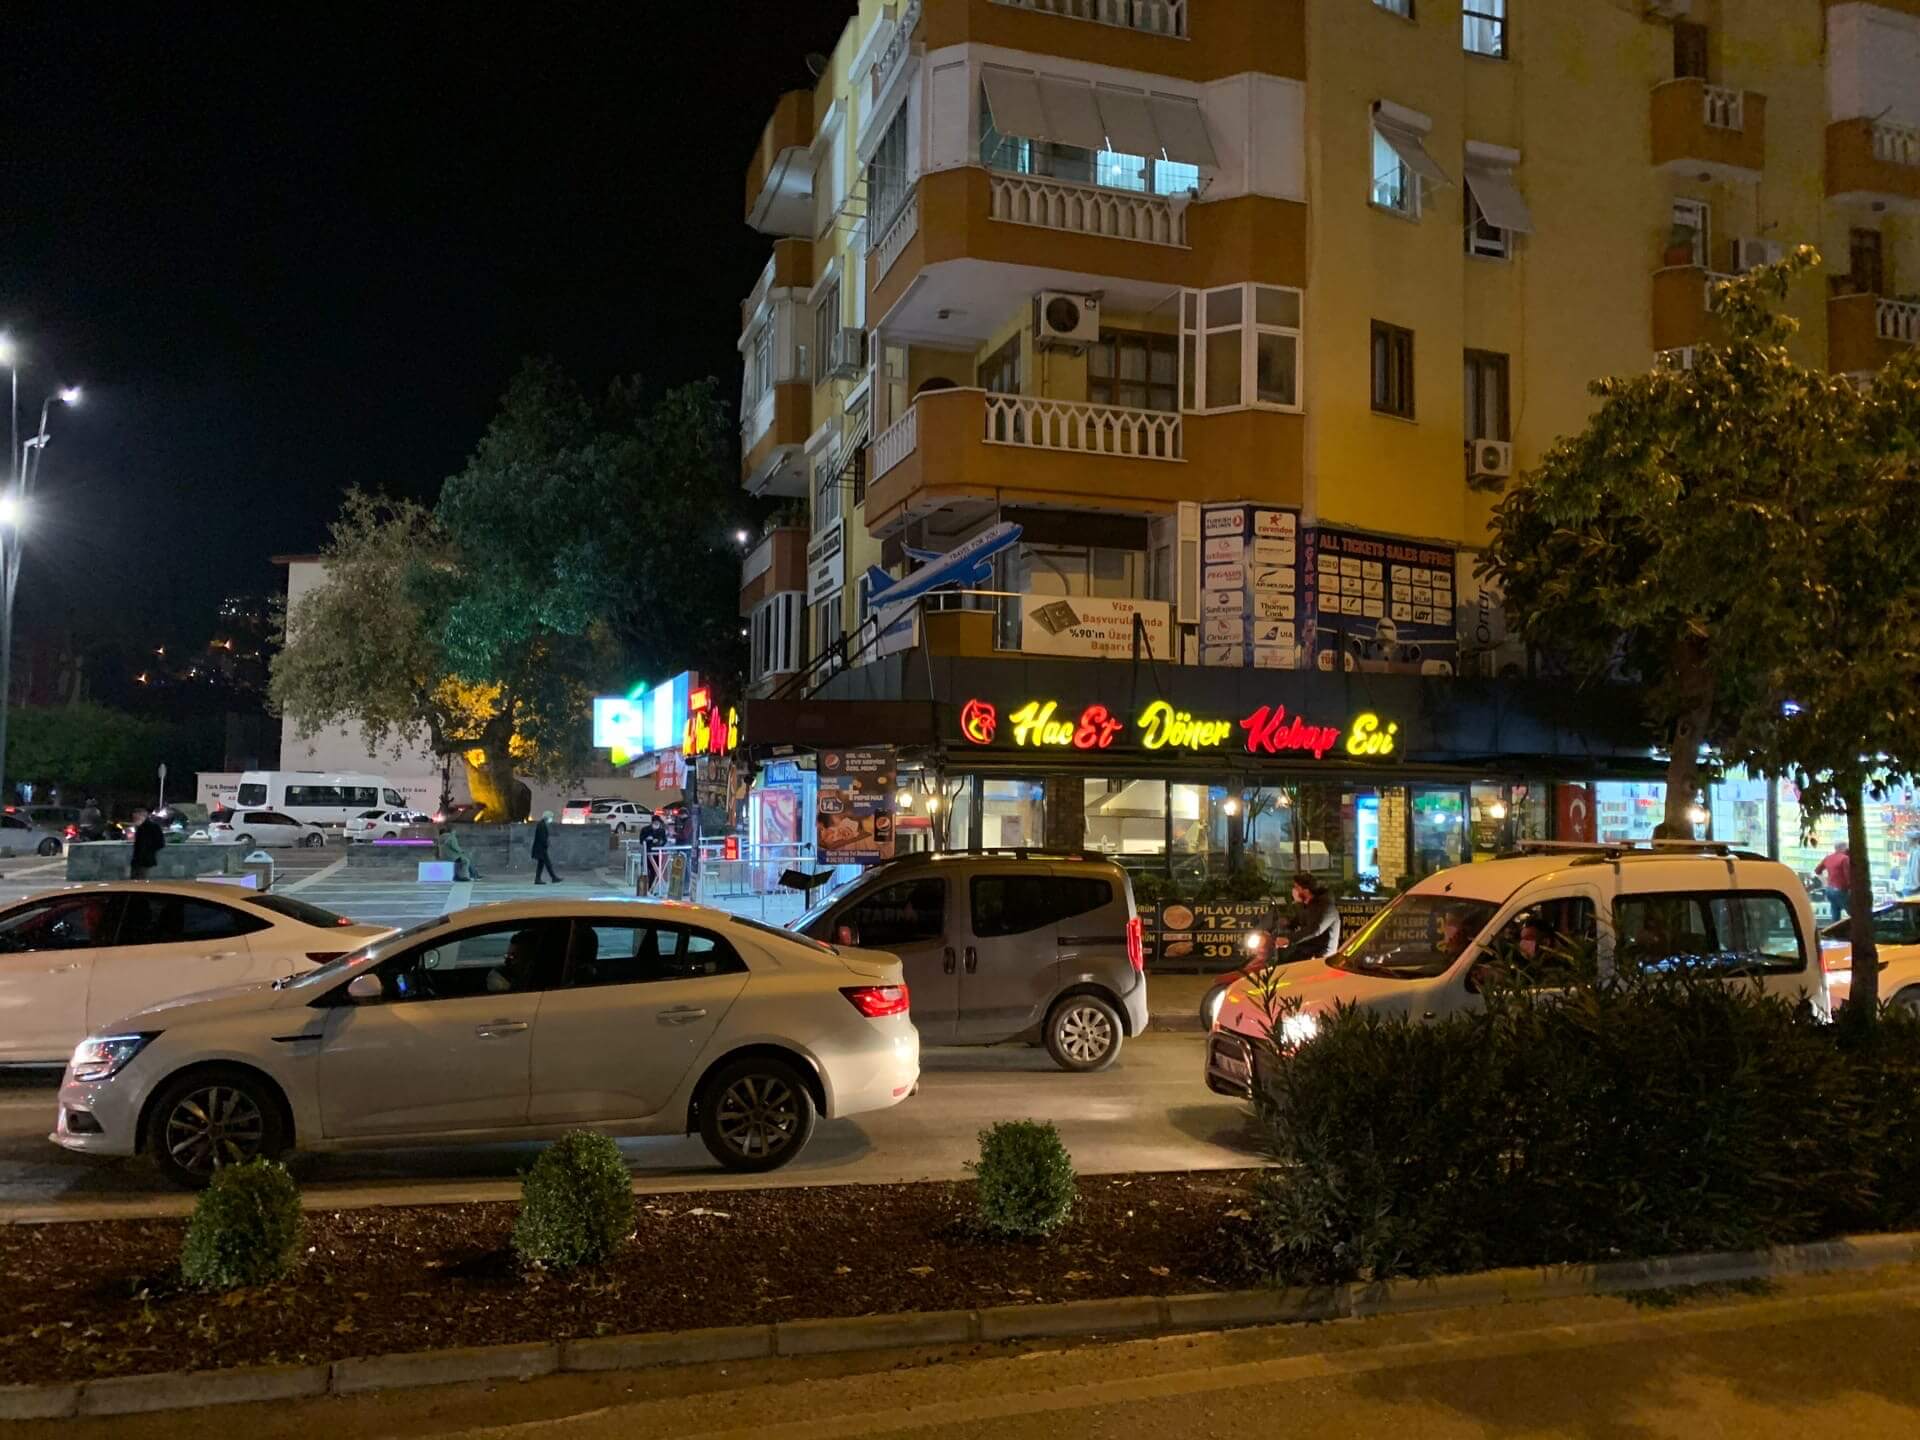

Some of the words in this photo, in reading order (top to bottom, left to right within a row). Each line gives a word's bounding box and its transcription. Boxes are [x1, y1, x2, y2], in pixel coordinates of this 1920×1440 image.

[1320, 534, 1340, 550] ALL
[1341, 537, 1385, 558] TICKETS
[1112, 601, 1134, 611] Vize
[1138, 700, 1231, 750] Döner
[1239, 704, 1341, 759] Kebap
[1347, 713, 1398, 755] Evi
[1194, 905, 1233, 915] PİLAV
[1204, 916, 1237, 929] 12
[1203, 944, 1233, 957] 30
